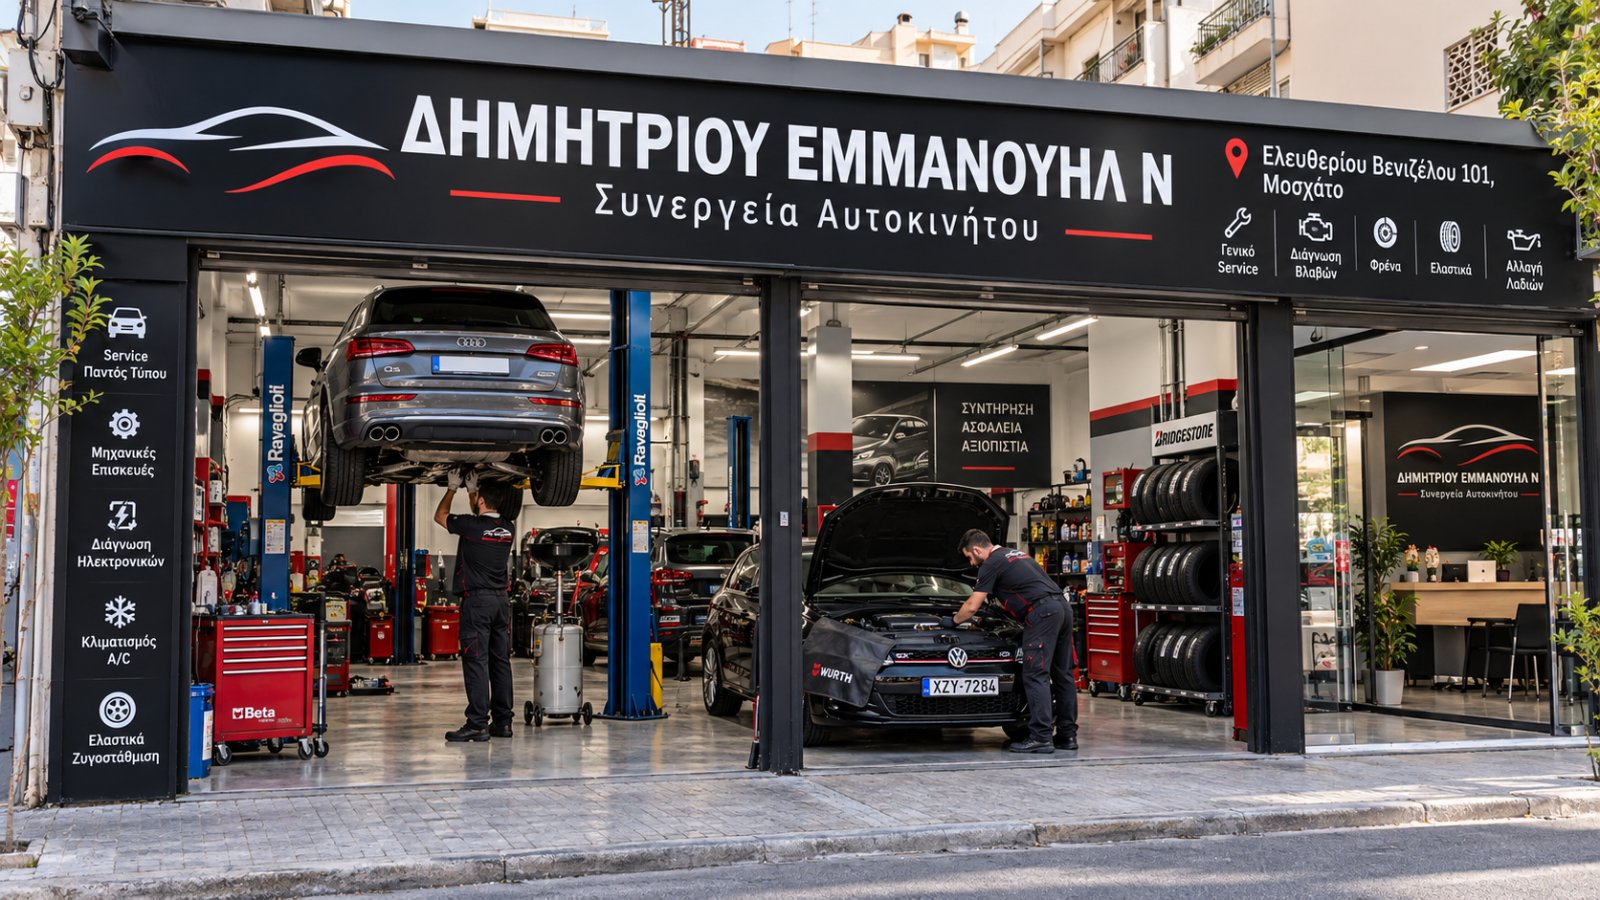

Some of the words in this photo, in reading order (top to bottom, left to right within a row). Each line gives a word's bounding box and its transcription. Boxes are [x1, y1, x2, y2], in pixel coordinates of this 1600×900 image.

[400, 94, 771, 178] ΔΗΜΗΤΡΙΟΥ
[787, 124, 1128, 204] ΕΜΜΑΝΟΥΗΛ
[1262, 144, 1367, 177] Ελευθερίου
[1372, 154, 1456, 183] Βενιζέλου
[1461, 164, 1495, 189] 101,
[1263, 173, 1344, 202] Μοσχάτο
[594, 183, 799, 231] Συνεργεία
[817, 198, 1039, 246] Αυτοκινήτου
[1221, 243, 1256, 258] Γενικό
[1290, 247, 1342, 266] Διάγνωση
[1218, 260, 1259, 276] Service
[1295, 265, 1338, 281] Βλαβών
[1370, 258, 1402, 274] Φρένα
[1430, 261, 1473, 276] Ελαστικά
[1506, 259, 1544, 277] Αλλαγή
[1506, 277, 1545, 291] Λαδιών
[103, 348, 149, 363] Service
[84, 365, 128, 381] Παντός
[130, 366, 167, 380] Τύπου
[961, 401, 1035, 416] ΣΥΝΤΗΡΗΣΗ
[961, 421, 1023, 434] ΑΣΦΑΛΕΙΑ
[1154, 422, 1214, 447] BRIDGESTONE
[91, 445, 157, 462] Μηχανικές
[961, 439, 1029, 453] ΑΞΙΟΠΙΣΤΙΑ
[91, 463, 155, 479] Επισκευές
[1397, 472, 1458, 484] ΔΗΜΗΤΡΙΟΥ
[1461, 472, 1528, 484] ΕΜΜΑΝΟΥΗΛ
[1420, 489, 1464, 500] Συνεργεία
[1466, 489, 1519, 500] Αυτοκινήτου
[91, 537, 152, 553] Διάγνωση
[77, 554, 165, 570] Ηλεκτρονικών
[81, 634, 157, 651] Κλιματισμός
[106, 652, 131, 666] A/C
[820, 666, 854, 684] WURTH
[933, 679, 996, 694] XZY-7284
[244, 706, 276, 719] Beta
[88, 732, 145, 747] Ελαστικά
[72, 750, 160, 767] Ζυγοστάθμιση
